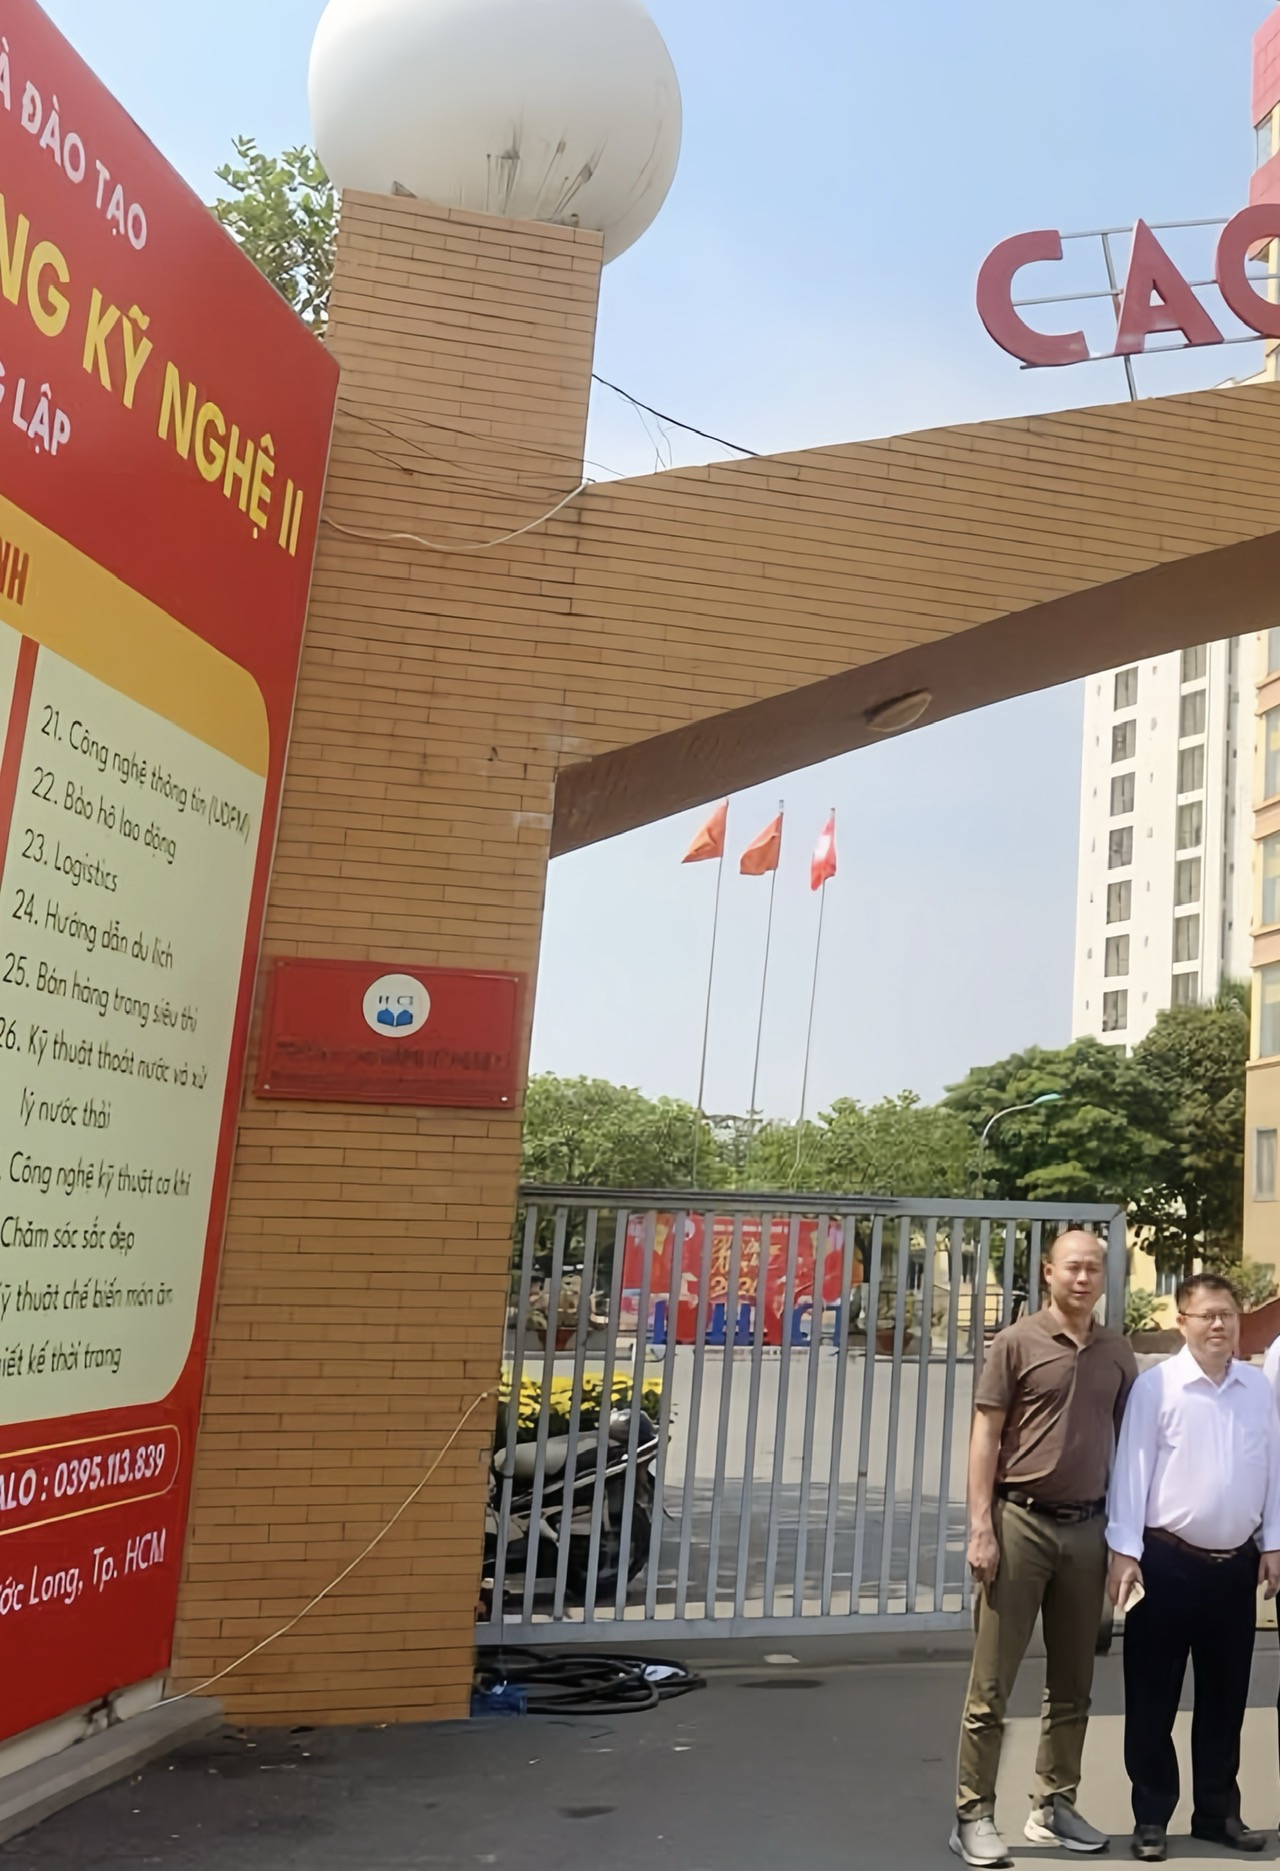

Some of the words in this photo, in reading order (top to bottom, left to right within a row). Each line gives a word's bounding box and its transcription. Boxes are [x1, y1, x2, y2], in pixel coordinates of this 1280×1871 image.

[21, 80, 86, 184] ĐÀO
[95, 159, 147, 250] TẠO
[12, 377, 71, 456] LẬP
[83, 287, 153, 409] KỸ
[158, 361, 275, 539] NGHỆ
[278, 479, 303, 557] II
[41, 705, 62, 741] 21.
[69, 720, 109, 773] Công
[32, 766, 58, 805] 22.
[22, 828, 48, 866] 23.
[54, 840, 118, 892] Logistics
[12, 889, 38, 925] 24.
[132, 932, 149, 962] du
[2, 952, 30, 988] 25.
[36, 961, 66, 997] Bán
[39, 1097, 78, 1126] nước
[9, 1151, 52, 1194] Công
[0, 1216, 48, 1248] Chăm
[53, 1221, 78, 1249] sóc
[63, 1277, 92, 1310] chế
[27, 1340, 49, 1375] kế
[54, 1443, 165, 1498] 0395.113.839
[29, 1565, 83, 1604] Long,
[93, 1546, 118, 1593] Tp.
[124, 1528, 166, 1576] HCM
